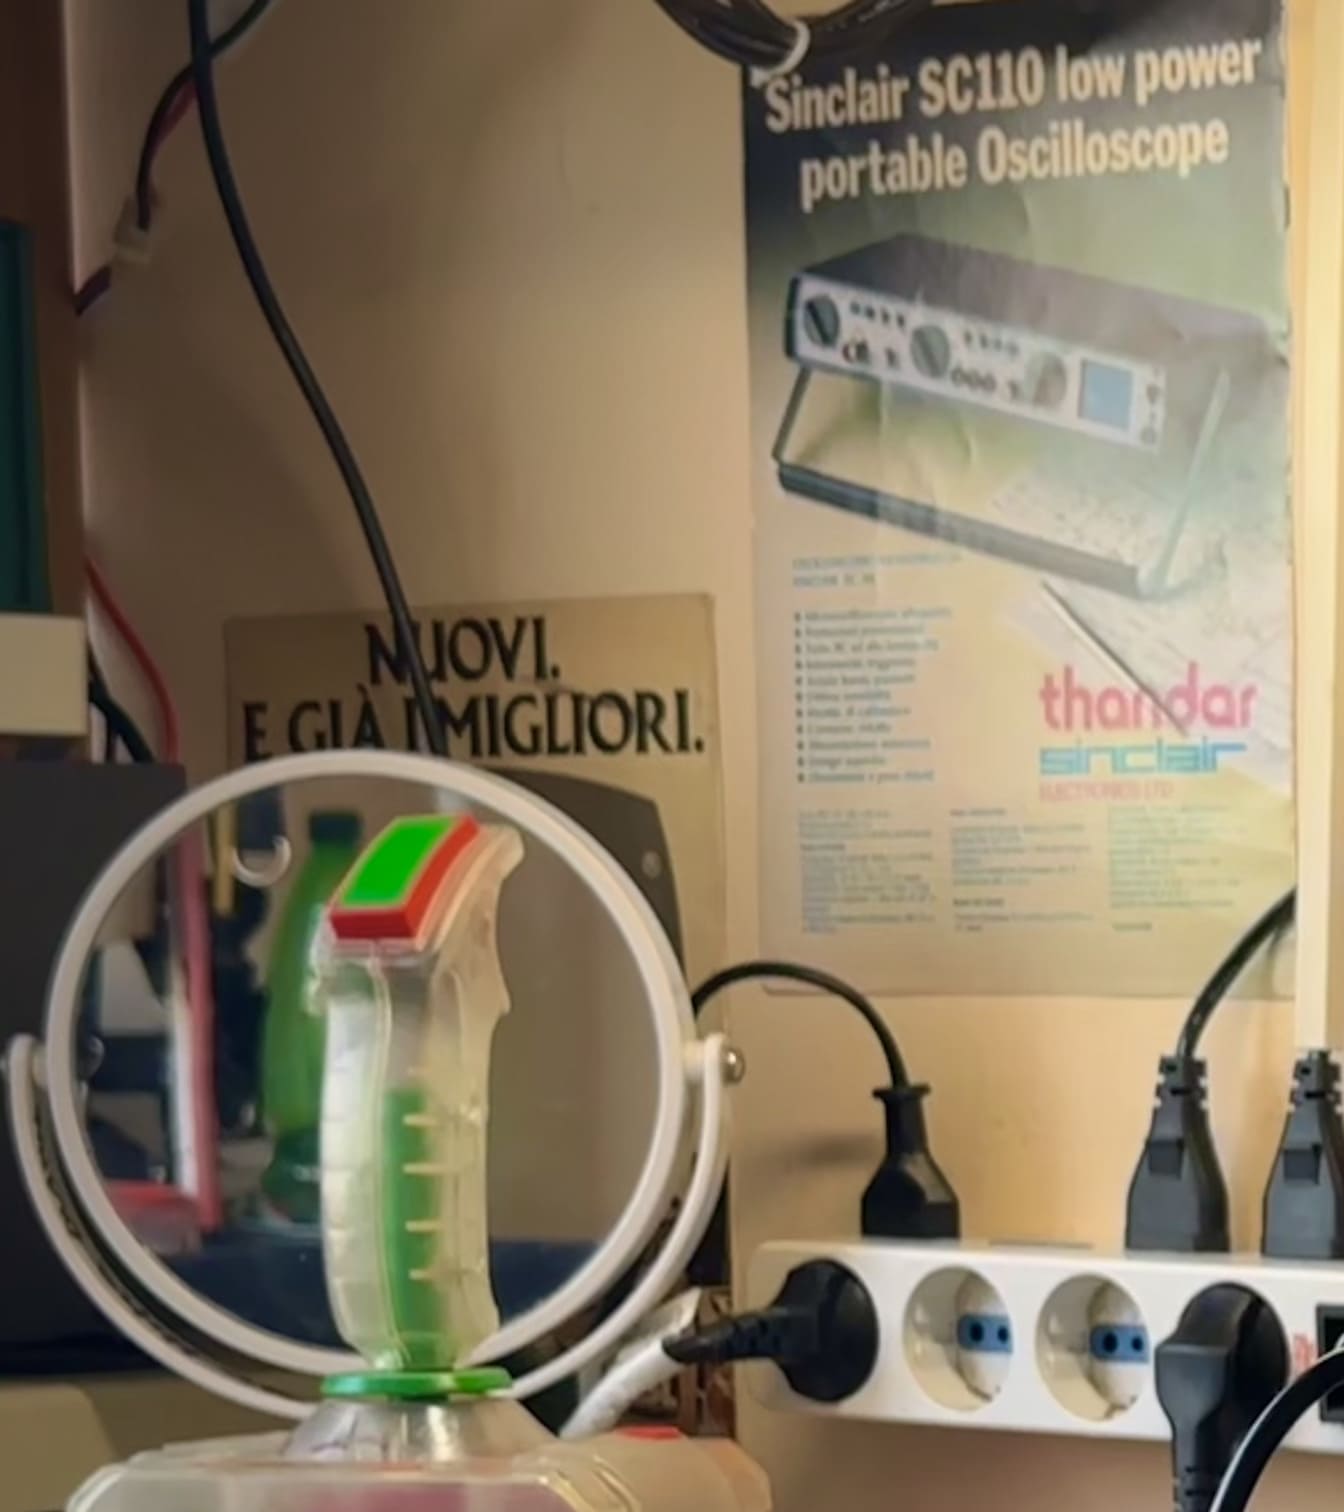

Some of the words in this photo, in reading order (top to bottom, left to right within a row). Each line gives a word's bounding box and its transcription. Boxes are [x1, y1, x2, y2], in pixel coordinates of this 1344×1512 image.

[765, 72, 910, 134] Sinclair
[919, 47, 1046, 118] SC110
[1056, 44, 1129, 98] low
[1135, 37, 1263, 104] power
[800, 136, 968, 212] portable
[978, 117, 1230, 184] Oscilloscope
[364, 616, 561, 686] NUOVI.
[243, 700, 273, 764] E
[1040, 660, 1258, 732] thandar
